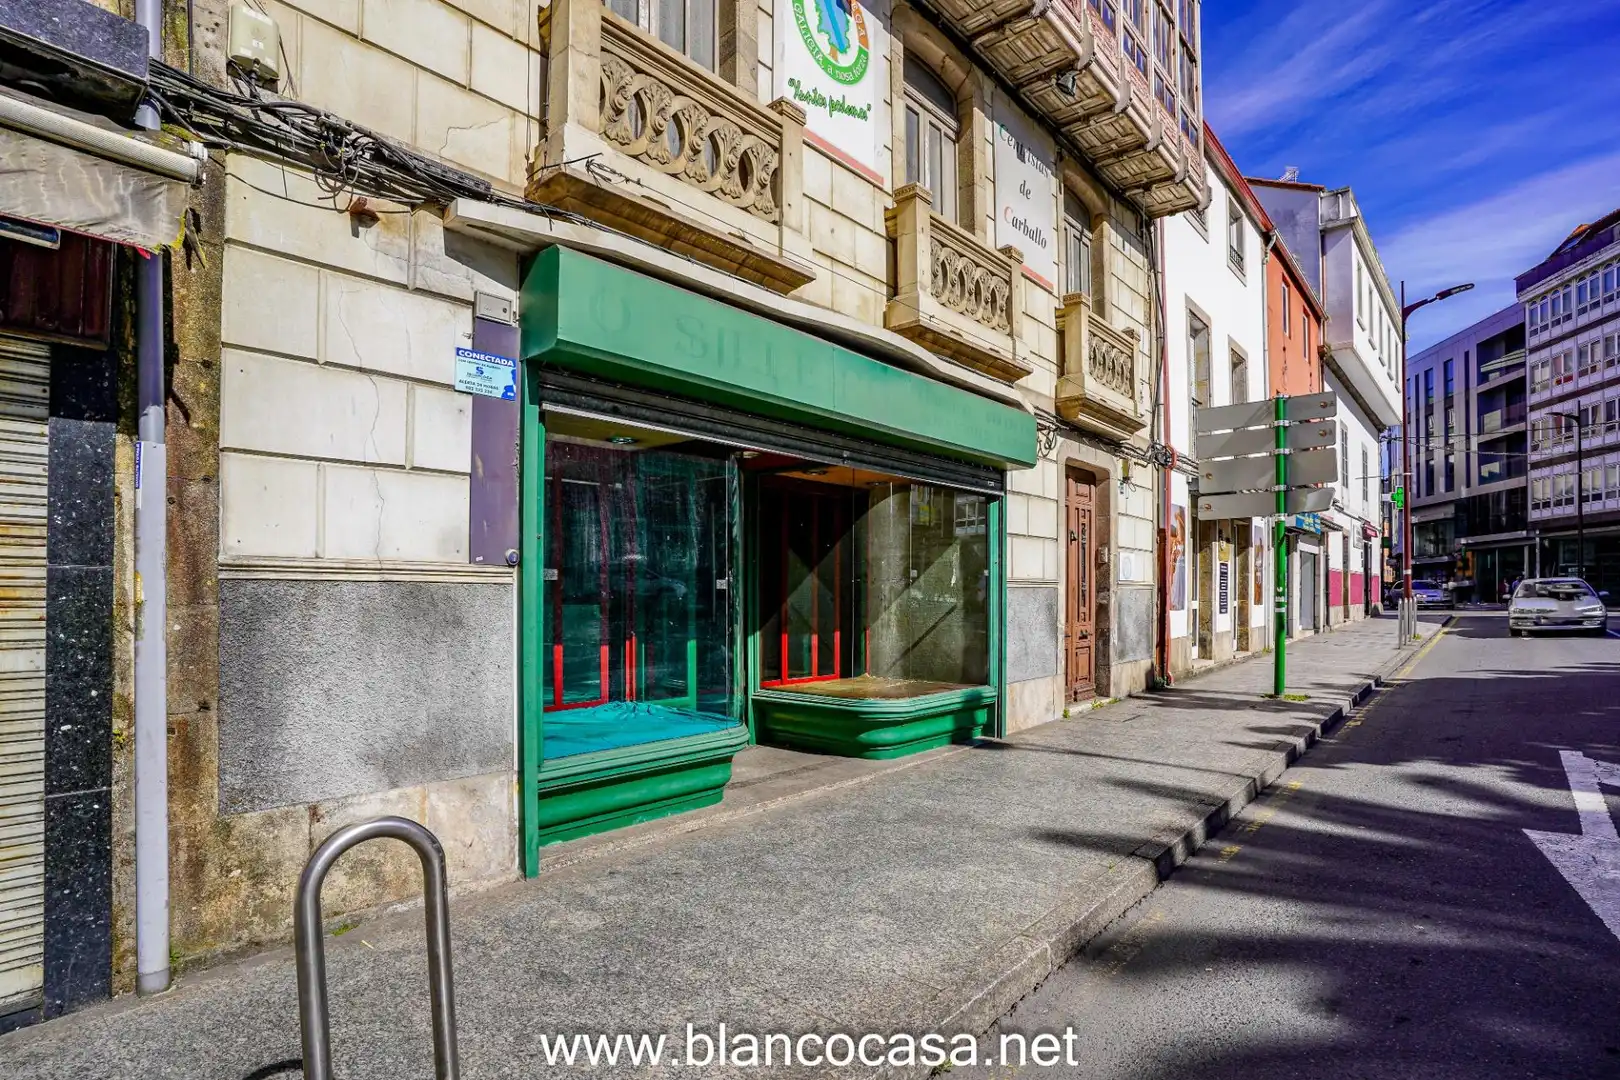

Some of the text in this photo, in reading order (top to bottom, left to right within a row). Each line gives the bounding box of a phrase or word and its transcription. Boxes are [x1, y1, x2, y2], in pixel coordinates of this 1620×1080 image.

[1019, 179, 1032, 200] de
[1003, 206, 1047, 249] Carballo
[459, 350, 514, 367] CONECTADA
